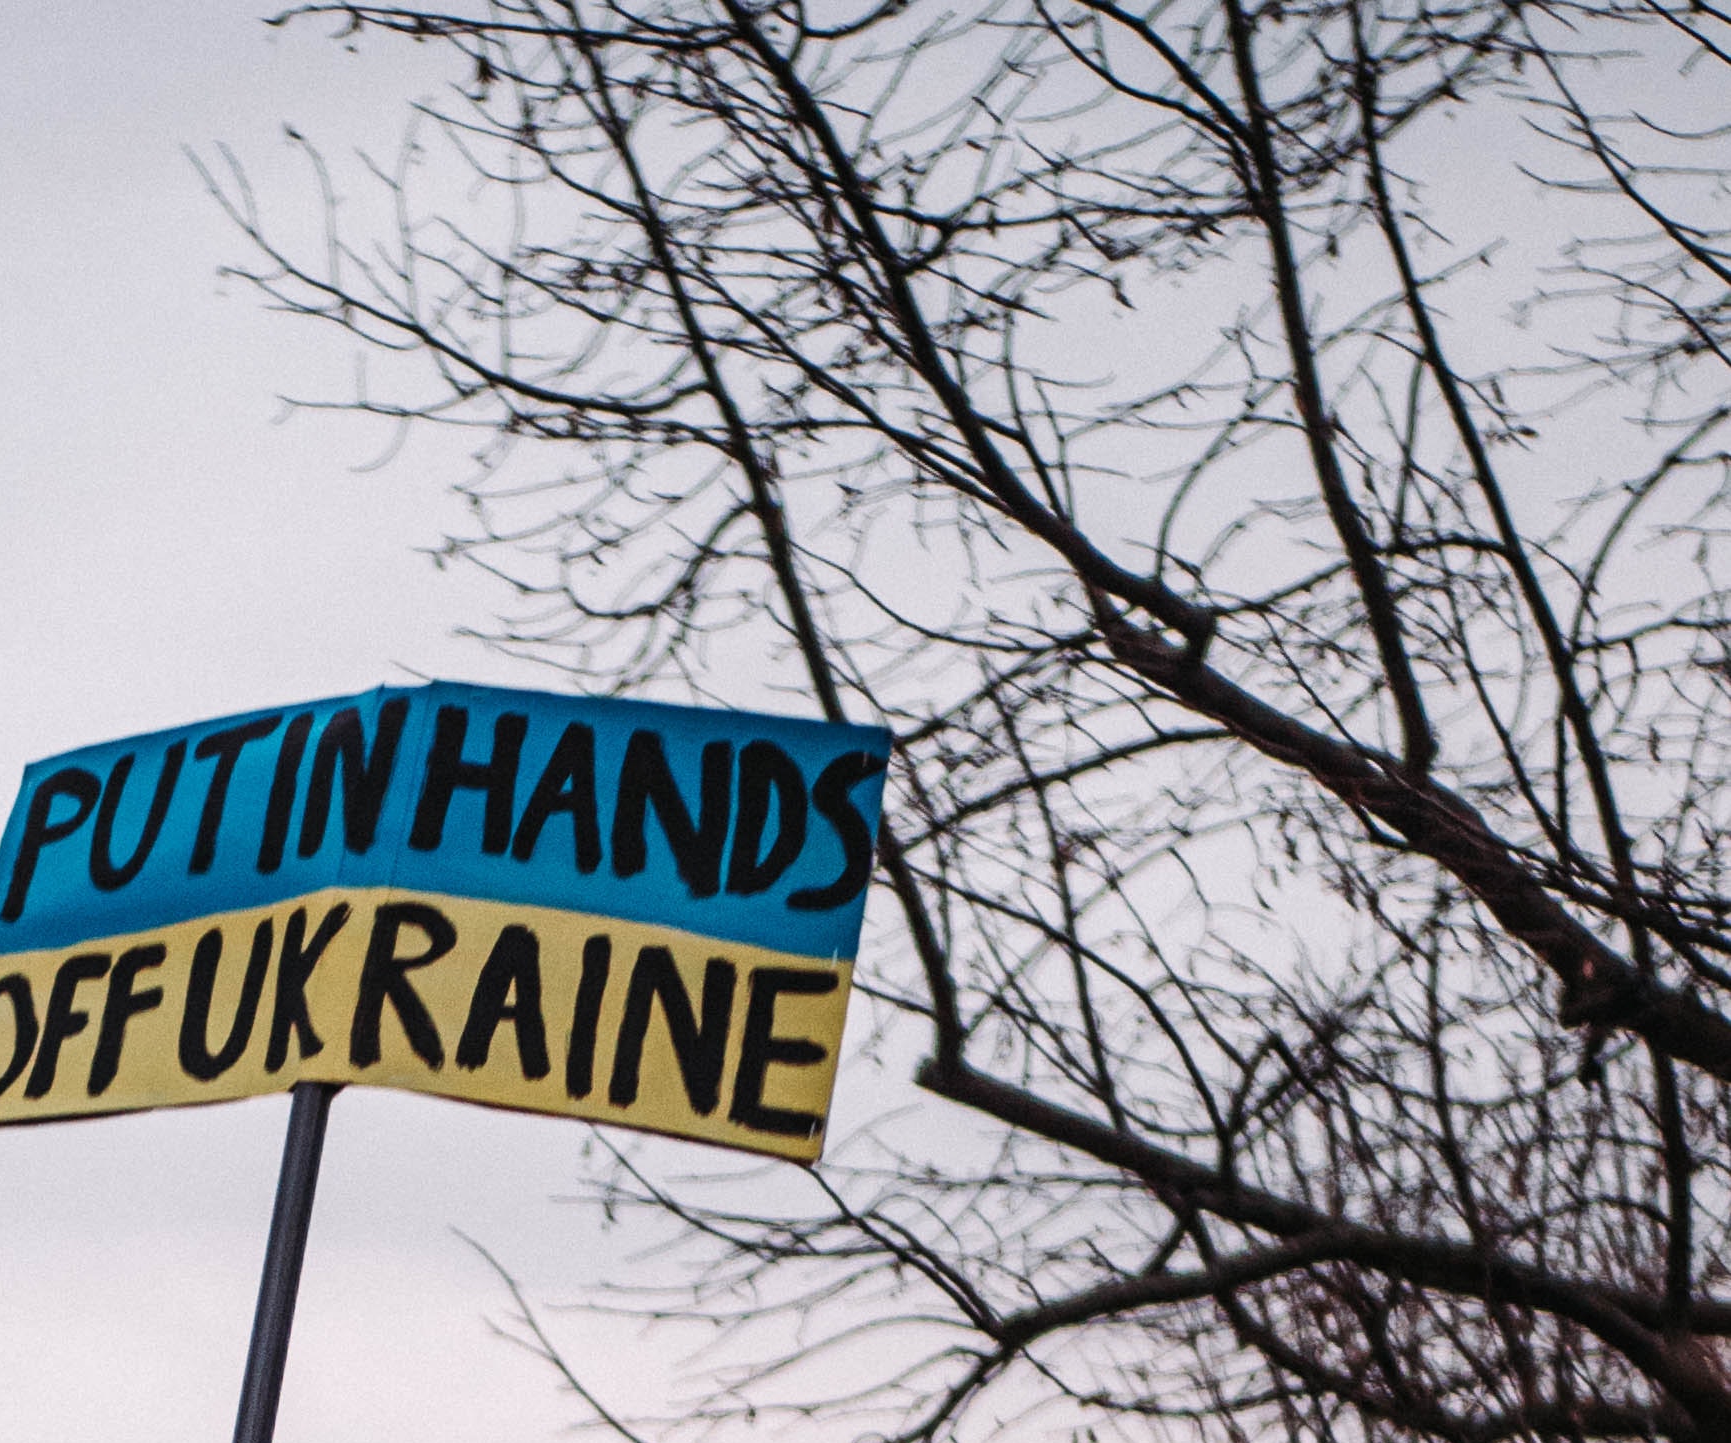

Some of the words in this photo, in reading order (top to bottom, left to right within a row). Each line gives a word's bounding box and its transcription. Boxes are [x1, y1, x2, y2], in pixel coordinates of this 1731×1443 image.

[0, 696, 410, 924] PUTIN
[407, 704, 890, 911] HANDS
[176, 901, 840, 1137] UKRAINE
